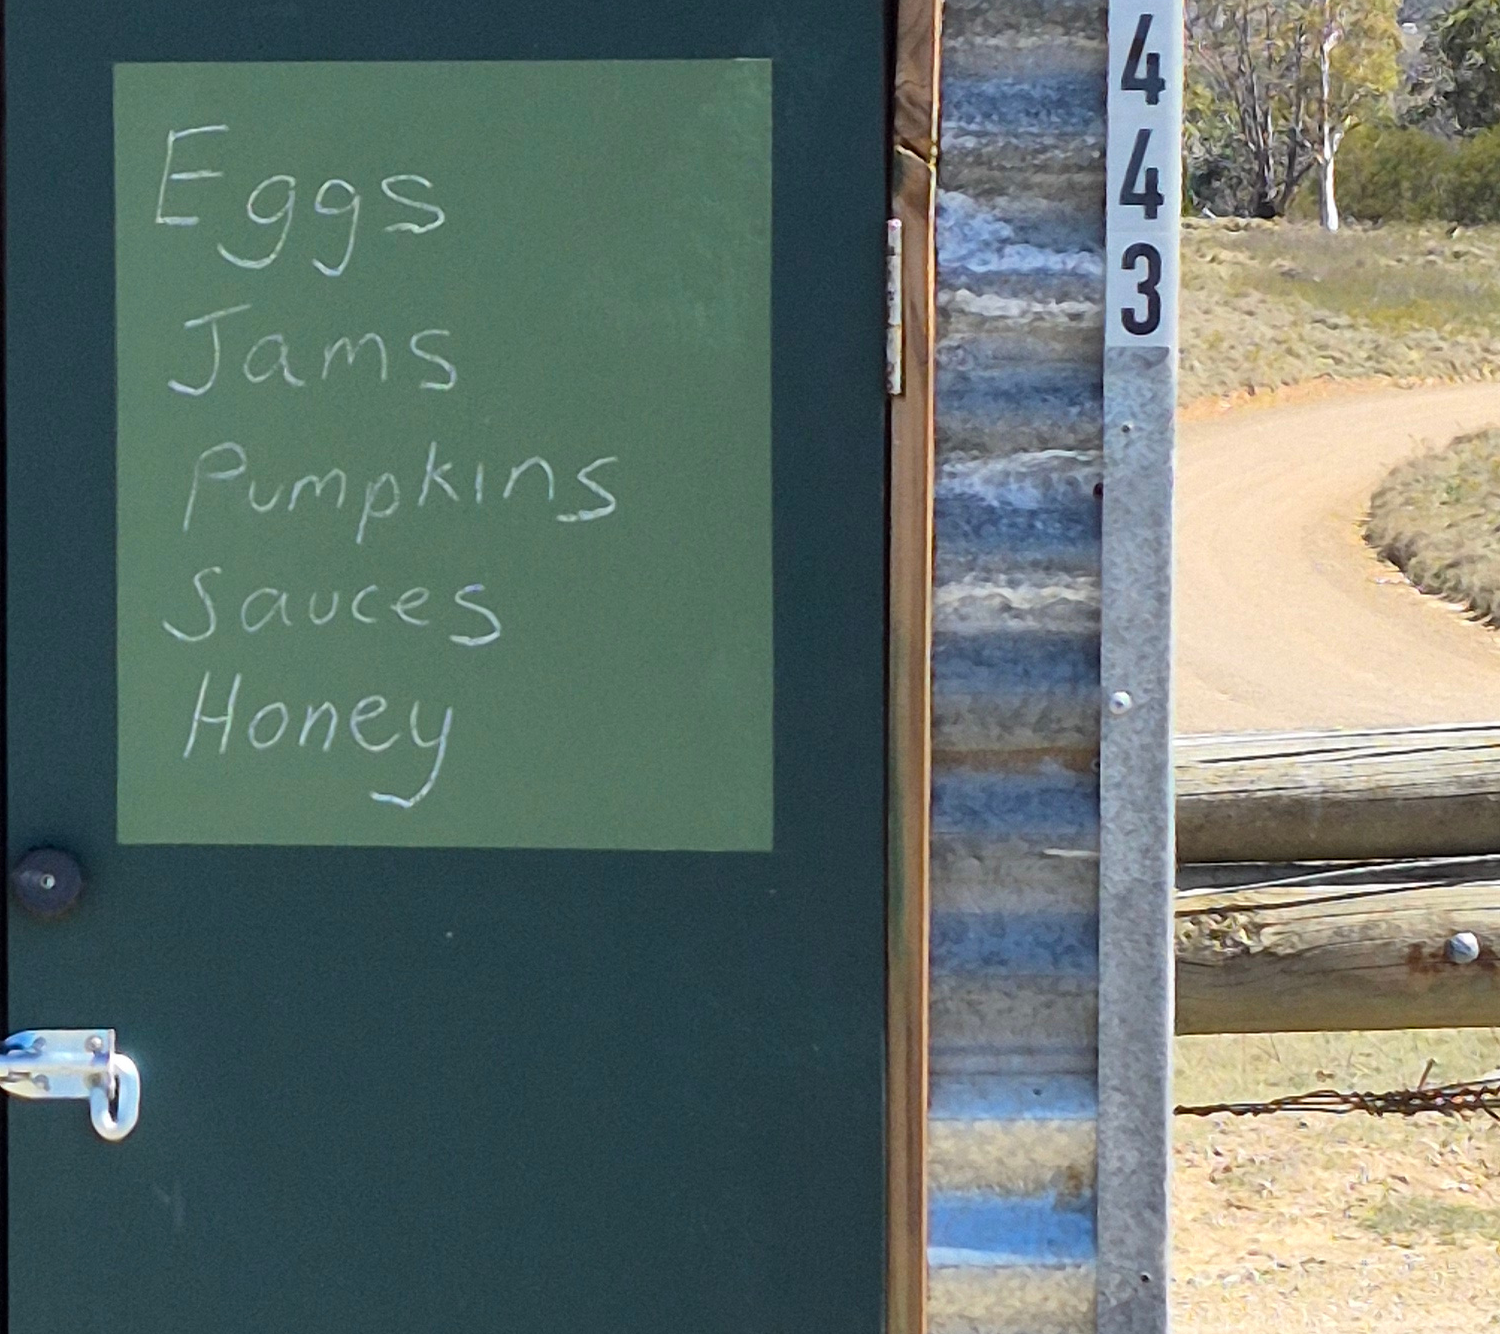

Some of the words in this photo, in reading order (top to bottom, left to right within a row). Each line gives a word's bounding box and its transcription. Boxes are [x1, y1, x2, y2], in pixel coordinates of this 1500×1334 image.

[155, 123, 446, 276] Eggs
[167, 304, 457, 396] Jams
[182, 441, 619, 545] Pumpkins
[162, 566, 503, 647] Sauces
[183, 671, 453, 808] Honey
